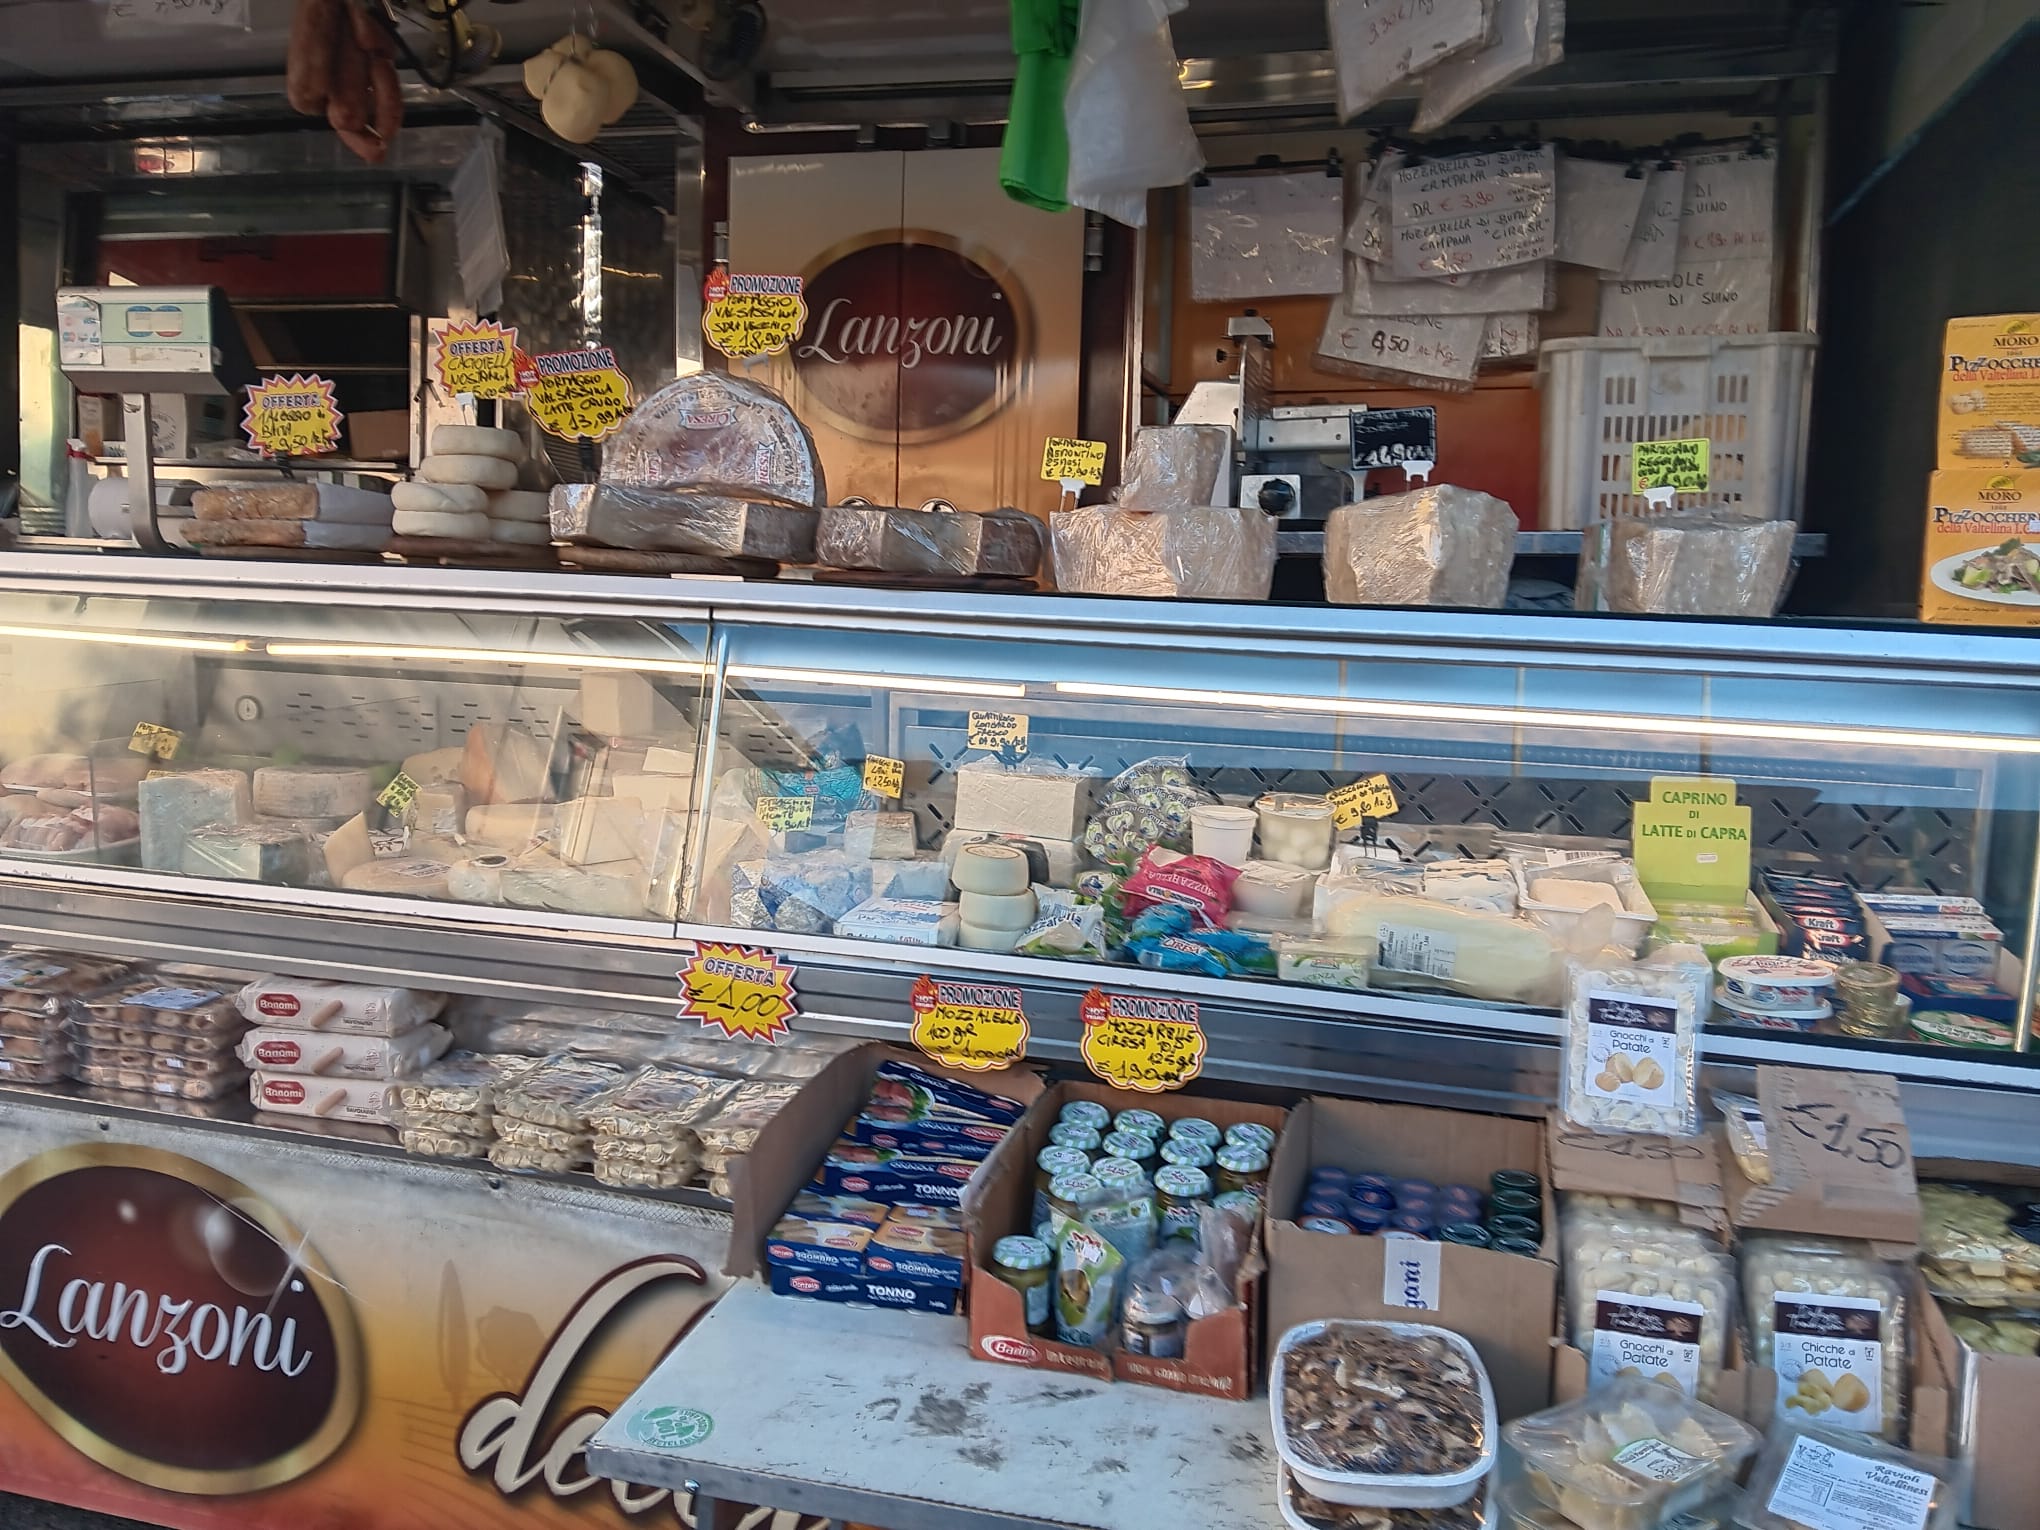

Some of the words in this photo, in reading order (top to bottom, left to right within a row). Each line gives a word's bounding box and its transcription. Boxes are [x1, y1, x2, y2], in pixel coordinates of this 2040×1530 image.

[731, 276, 801, 294] PROMOZIONE
[1701, 292, 1738, 305] SUINO
[797, 293, 1003, 369] Lanzoni
[450, 339, 505, 355] OFFERTA
[1993, 335, 2039, 347] MORO
[537, 350, 614, 376] PROMOZIONE
[1952, 369, 1978, 381] della
[1979, 367, 2028, 381] Valtellina
[262, 393, 321, 409] OFFERTA
[1977, 491, 2022, 501] MORO
[1937, 522, 1962, 534] della
[1965, 521, 2012, 534] Valtellina
[1662, 791, 1728, 805] CAPRINO
[1689, 810, 1700, 819] DI
[1642, 824, 1683, 837] LATTE
[1700, 826, 1748, 840] CAPRA
[1025, 912, 1082, 935] ozzarella
[1808, 918, 1835, 928] Kraft
[704, 958, 776, 987] OFFERTA
[940, 985, 1019, 1008] PROMOZIONE
[260, 999, 298, 1010] Bonomi
[1111, 997, 1197, 1022] PROMOZIONE
[1609, 1029, 1648, 1043] Gnocchi
[258, 1048, 297, 1058] Bonomi
[1612, 1039, 1652, 1054] Patate
[265, 1086, 303, 1098] Bonomi
[914, 1183, 960, 1197] TONNO
[866, 1283, 917, 1300] TONNO
[0, 1244, 313, 1376] Lanzoni
[1619, 1339, 1665, 1354] Gnocchi
[1801, 1341, 1846, 1355] Chicche
[1622, 1351, 1669, 1368] Patate
[1804, 1353, 1853, 1370] Patate
[1874, 1464, 1921, 1484] Ravioli
[1865, 1470, 1929, 1497] Valtellinesi
